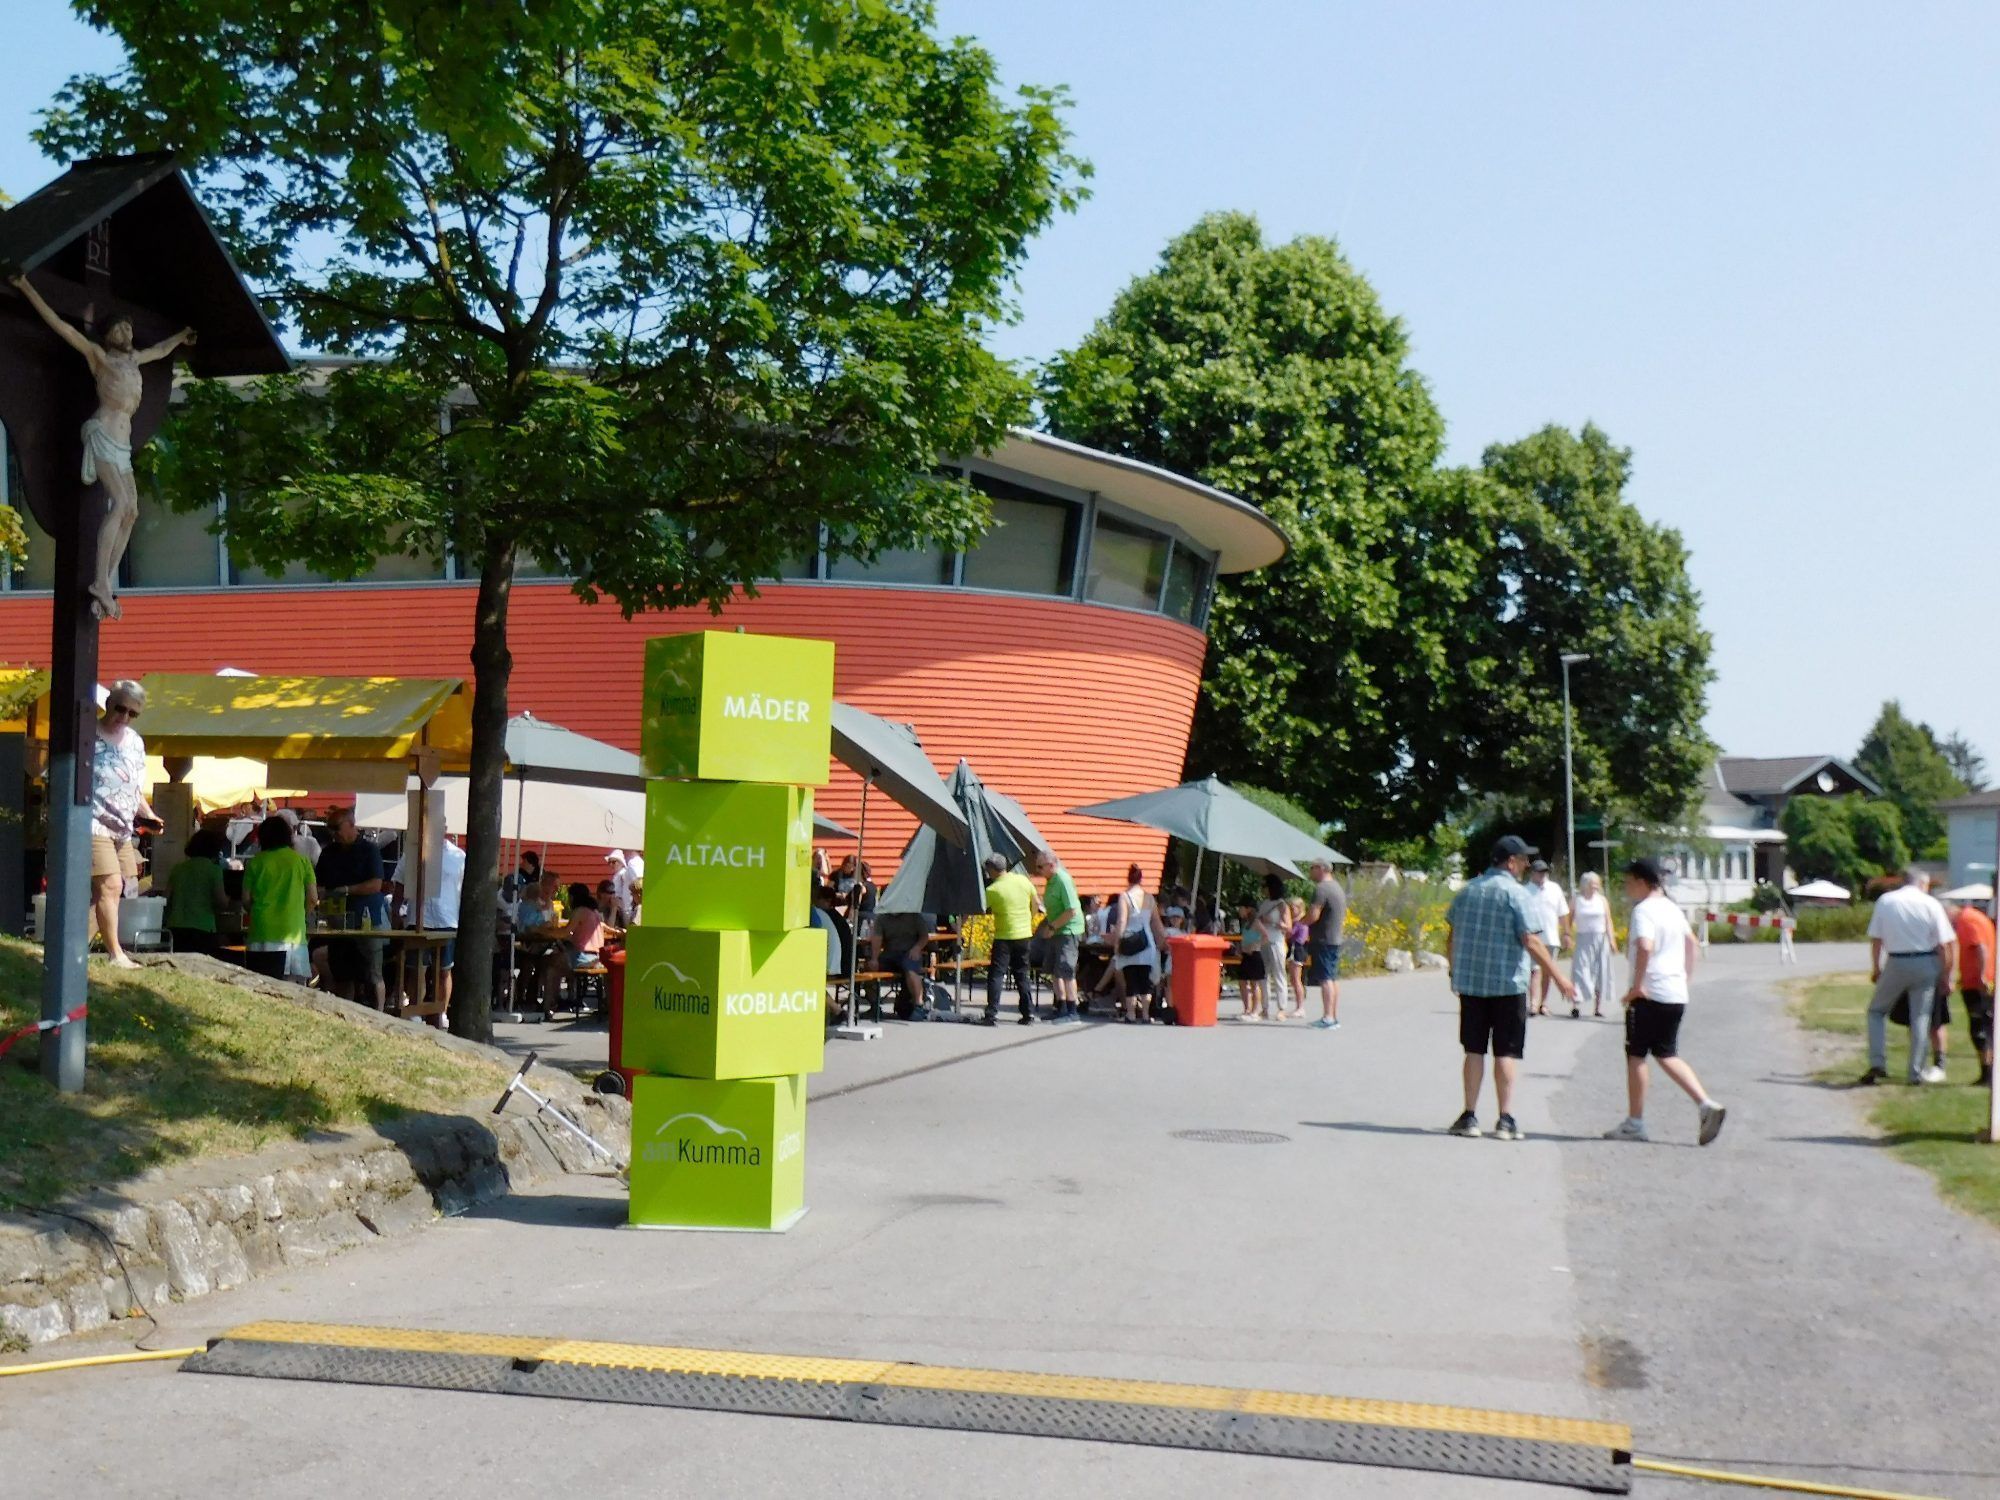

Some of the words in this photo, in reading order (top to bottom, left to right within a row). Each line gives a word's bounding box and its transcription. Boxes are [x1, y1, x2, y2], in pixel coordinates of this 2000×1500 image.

[723, 693, 810, 723] MÄDER
[666, 843, 766, 868] ALTACH
[655, 985, 710, 1015] Kumma
[726, 991, 818, 1016] KOBLACH
